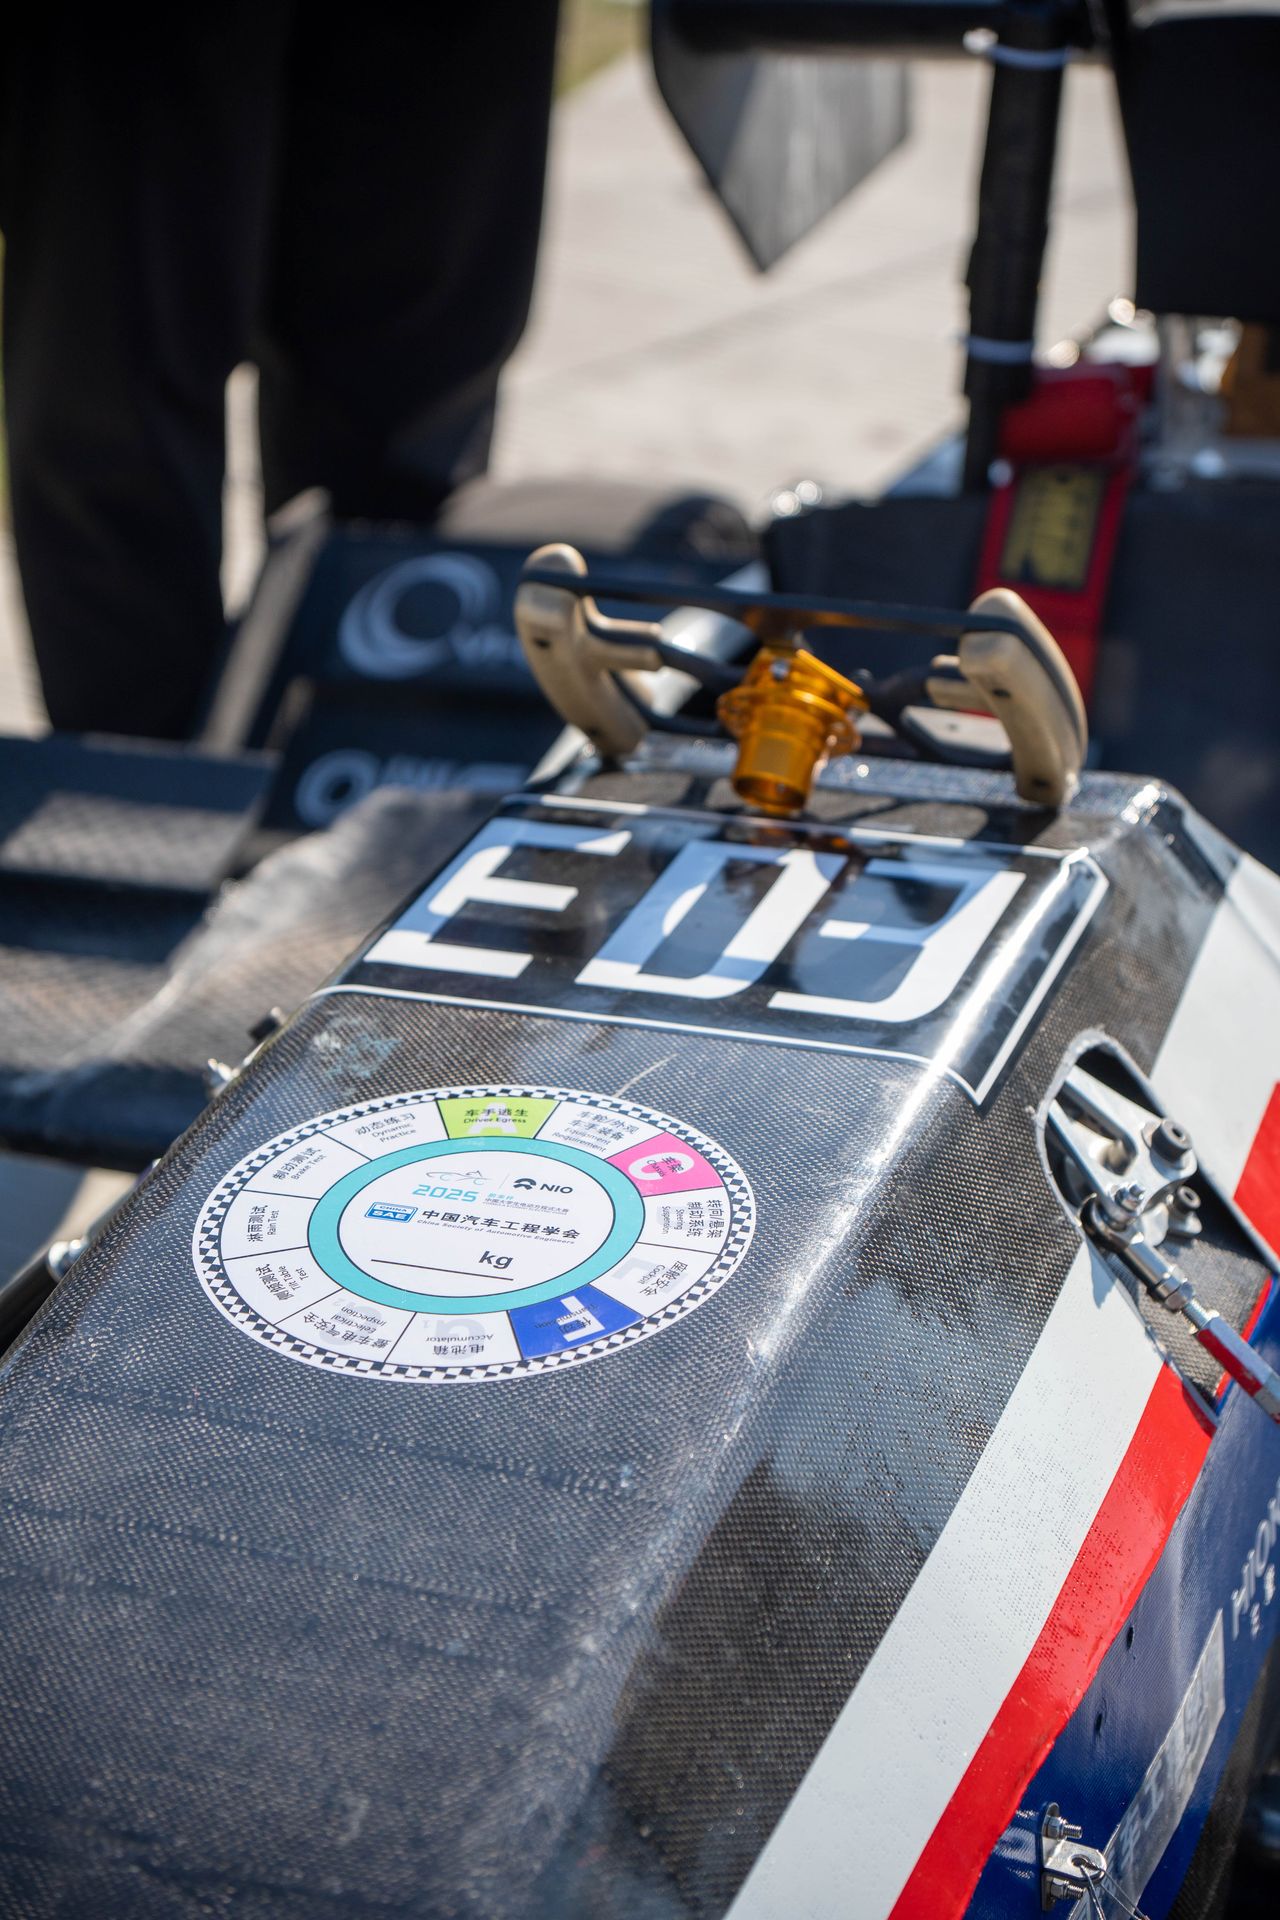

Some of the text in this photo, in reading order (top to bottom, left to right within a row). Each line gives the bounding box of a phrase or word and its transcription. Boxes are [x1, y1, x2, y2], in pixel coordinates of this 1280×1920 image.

[465, 1108, 529, 1117] 车手逃生
[356, 1113, 416, 1135] 动态练习
[372, 1123, 412, 1138] Dynamic
[568, 1119, 624, 1141] 车手装备
[379, 1129, 417, 1143] Practice
[552, 1132, 606, 1152] Requirement
[564, 1127, 610, 1145] Equipment
[272, 1147, 322, 1180] 制动测试
[290, 1155, 326, 1180] Brake Test
[412, 1184, 479, 1202] 2025
[540, 1184, 573, 1194] NIO
[246, 1205, 268, 1242] 淋雨测试
[267, 1209, 280, 1236] Rain Test
[372, 1210, 407, 1220] SAE
[422, 1210, 580, 1239] 中国汽车工程学会
[662, 1206, 671, 1235] Suspension
[674, 1209, 685, 1230] Steering
[687, 1201, 704, 1237] 制动系统
[706, 1200, 724, 1238] 转向/悬架
[442, 1222, 472, 1231] Society
[486, 1229, 532, 1239] Automotive
[534, 1236, 575, 1244] Engineers
[479, 1251, 513, 1270] kg
[256, 1263, 294, 1301] 侧倾测试
[278, 1265, 300, 1291] Tilt Table
[296, 1267, 309, 1281] Test
[638, 1264, 665, 1285] Cockpit
[640, 1260, 688, 1296] 座舱安全
[303, 1312, 392, 1349] 整车电气安全
[425, 1333, 494, 1342] Accumulator
[433, 1343, 485, 1356] 电池箱
